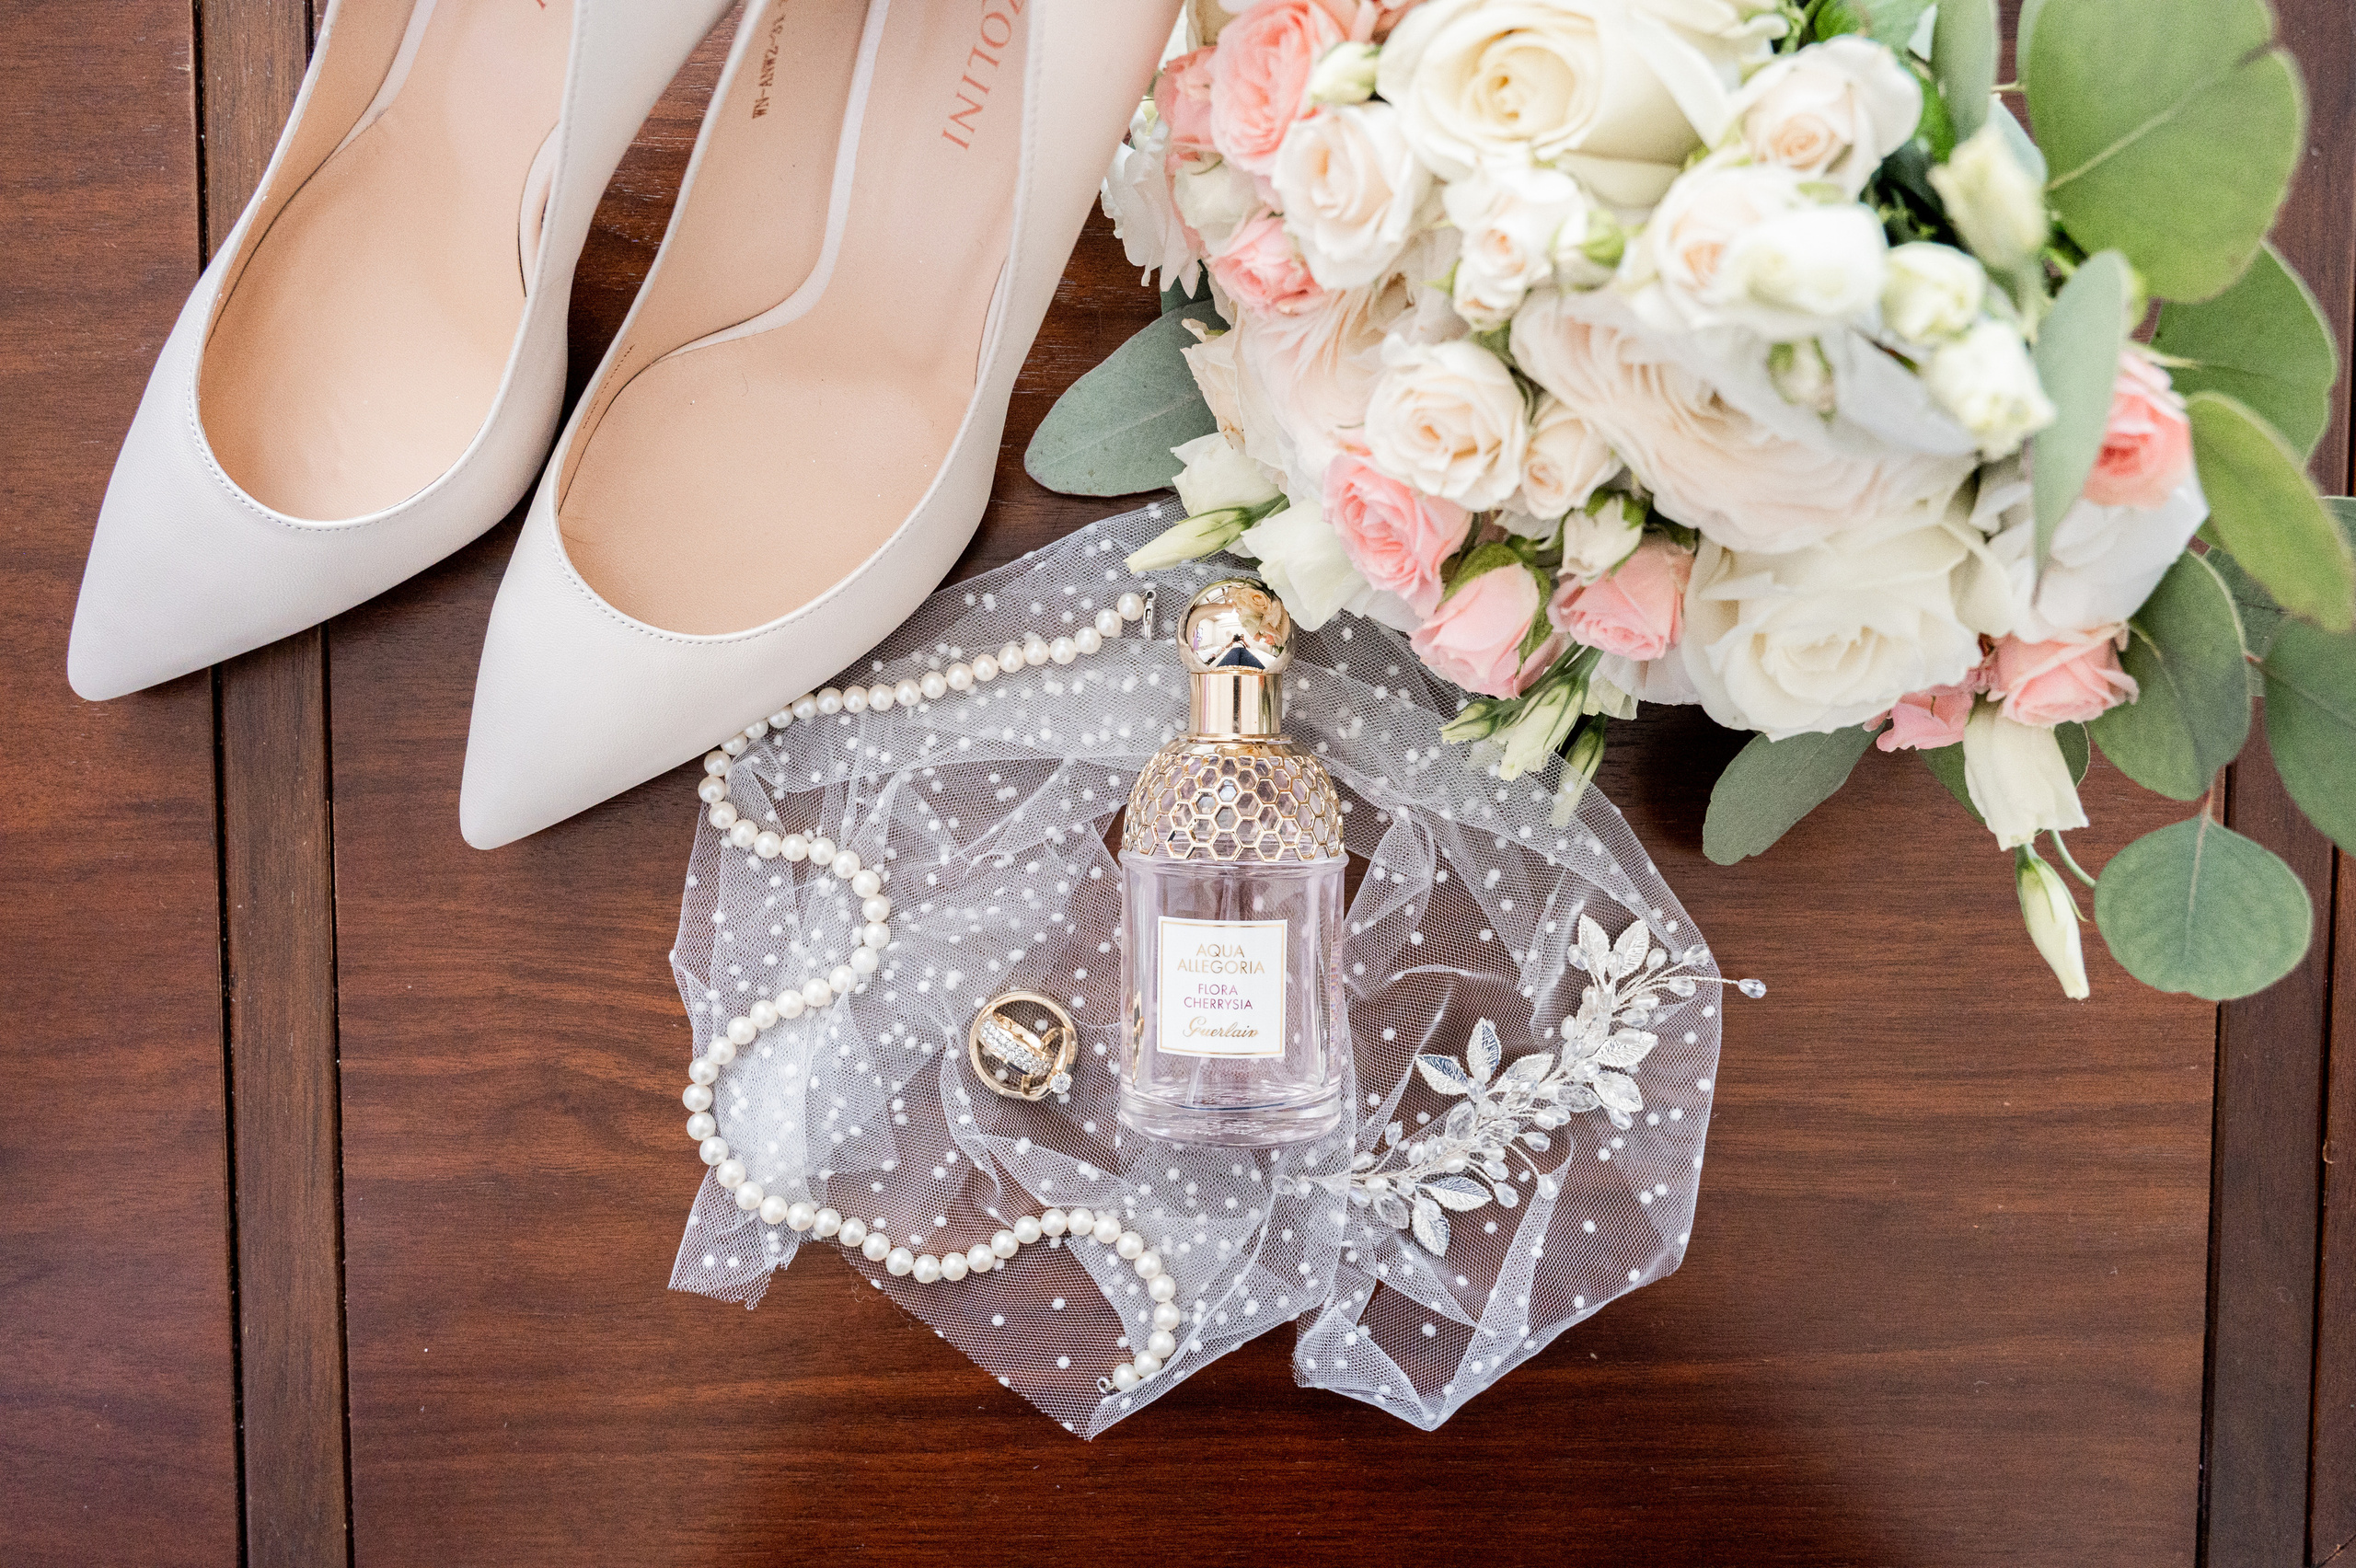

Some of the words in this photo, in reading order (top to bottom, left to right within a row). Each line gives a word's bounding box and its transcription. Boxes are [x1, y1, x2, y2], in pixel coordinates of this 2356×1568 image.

[1196, 943, 1245, 958] AQUA
[1177, 958, 1265, 974] ALLEGORIA
[1198, 983, 1238, 996] FLORA
[1184, 997, 1253, 1010] CHERRYSIA
[1183, 1016, 1259, 1038] Guerlain
